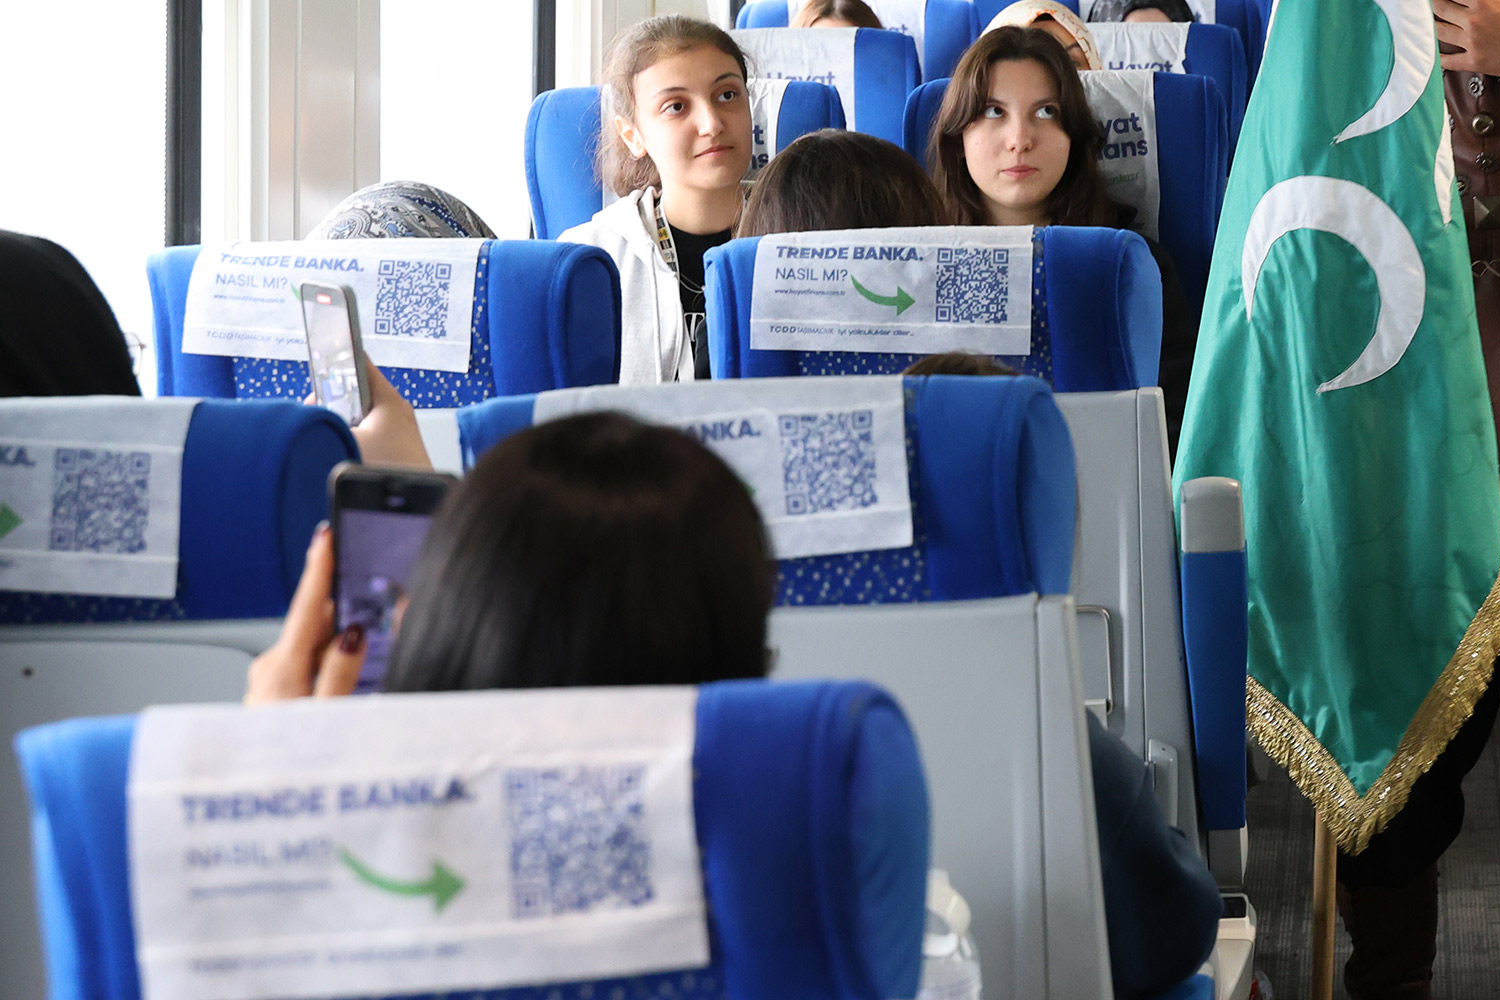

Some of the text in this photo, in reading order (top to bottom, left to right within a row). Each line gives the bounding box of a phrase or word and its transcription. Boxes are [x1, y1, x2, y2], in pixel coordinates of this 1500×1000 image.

[1103, 112, 1143, 138] yat
[219, 252, 366, 273] TRENDE BANKA.
[775, 246, 924, 262] TRENDE BANKA.
[215, 272, 289, 290] NASIL MI?
[775, 267, 849, 282] NASIL MI?
[684, 420, 761, 442] ANKA.
